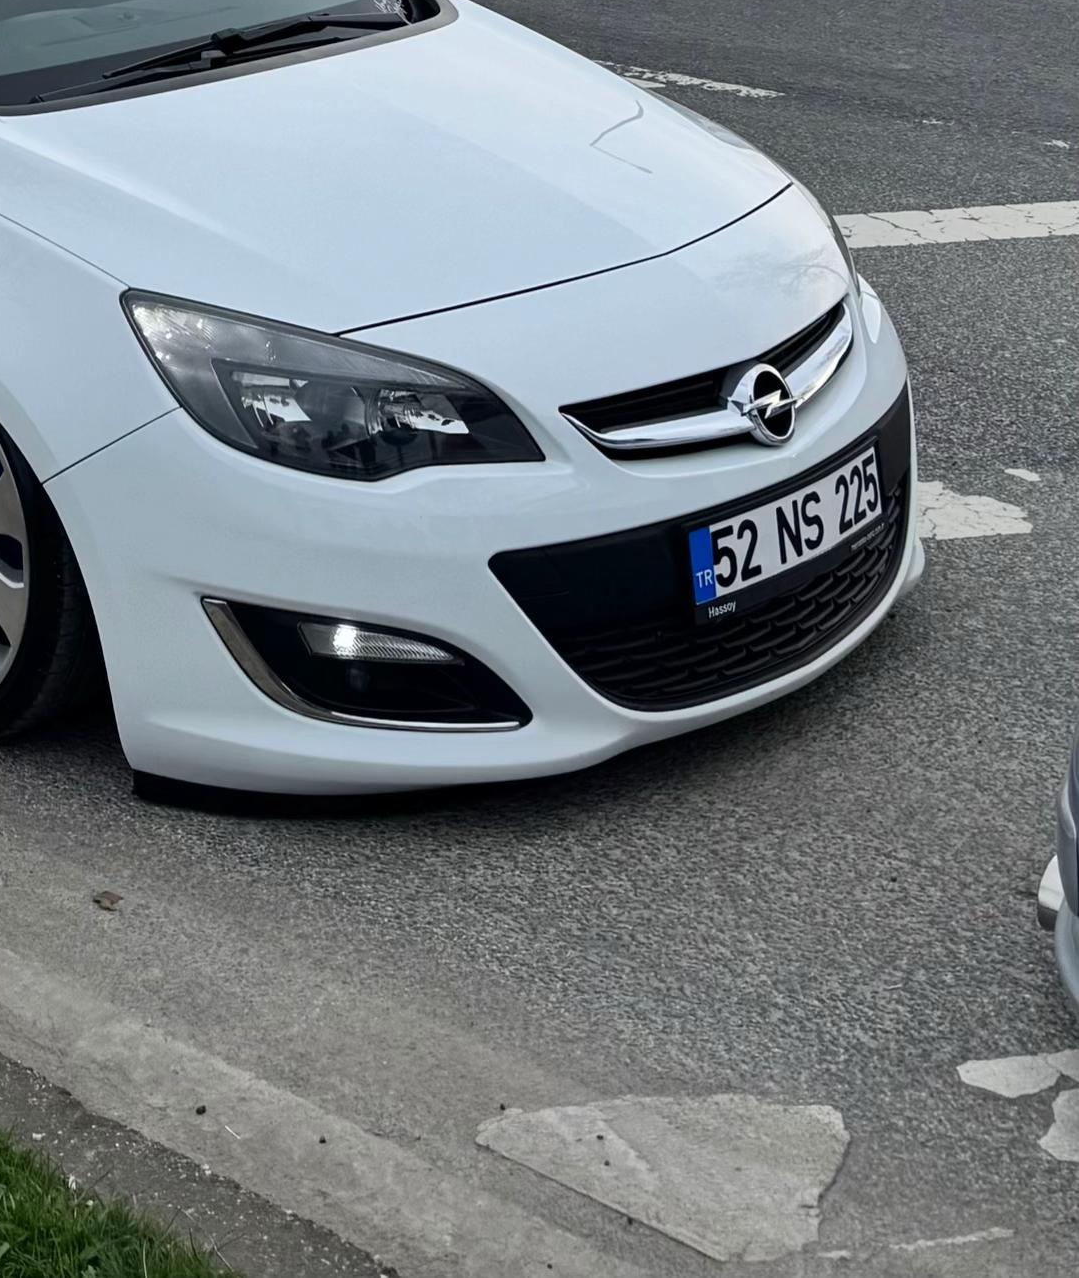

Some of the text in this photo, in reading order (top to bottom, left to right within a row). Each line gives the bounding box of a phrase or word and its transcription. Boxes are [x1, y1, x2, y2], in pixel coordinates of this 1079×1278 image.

[711, 454, 879, 588] 52 NS 225
[695, 569, 713, 588] TR
[708, 601, 736, 619] Hassoy
